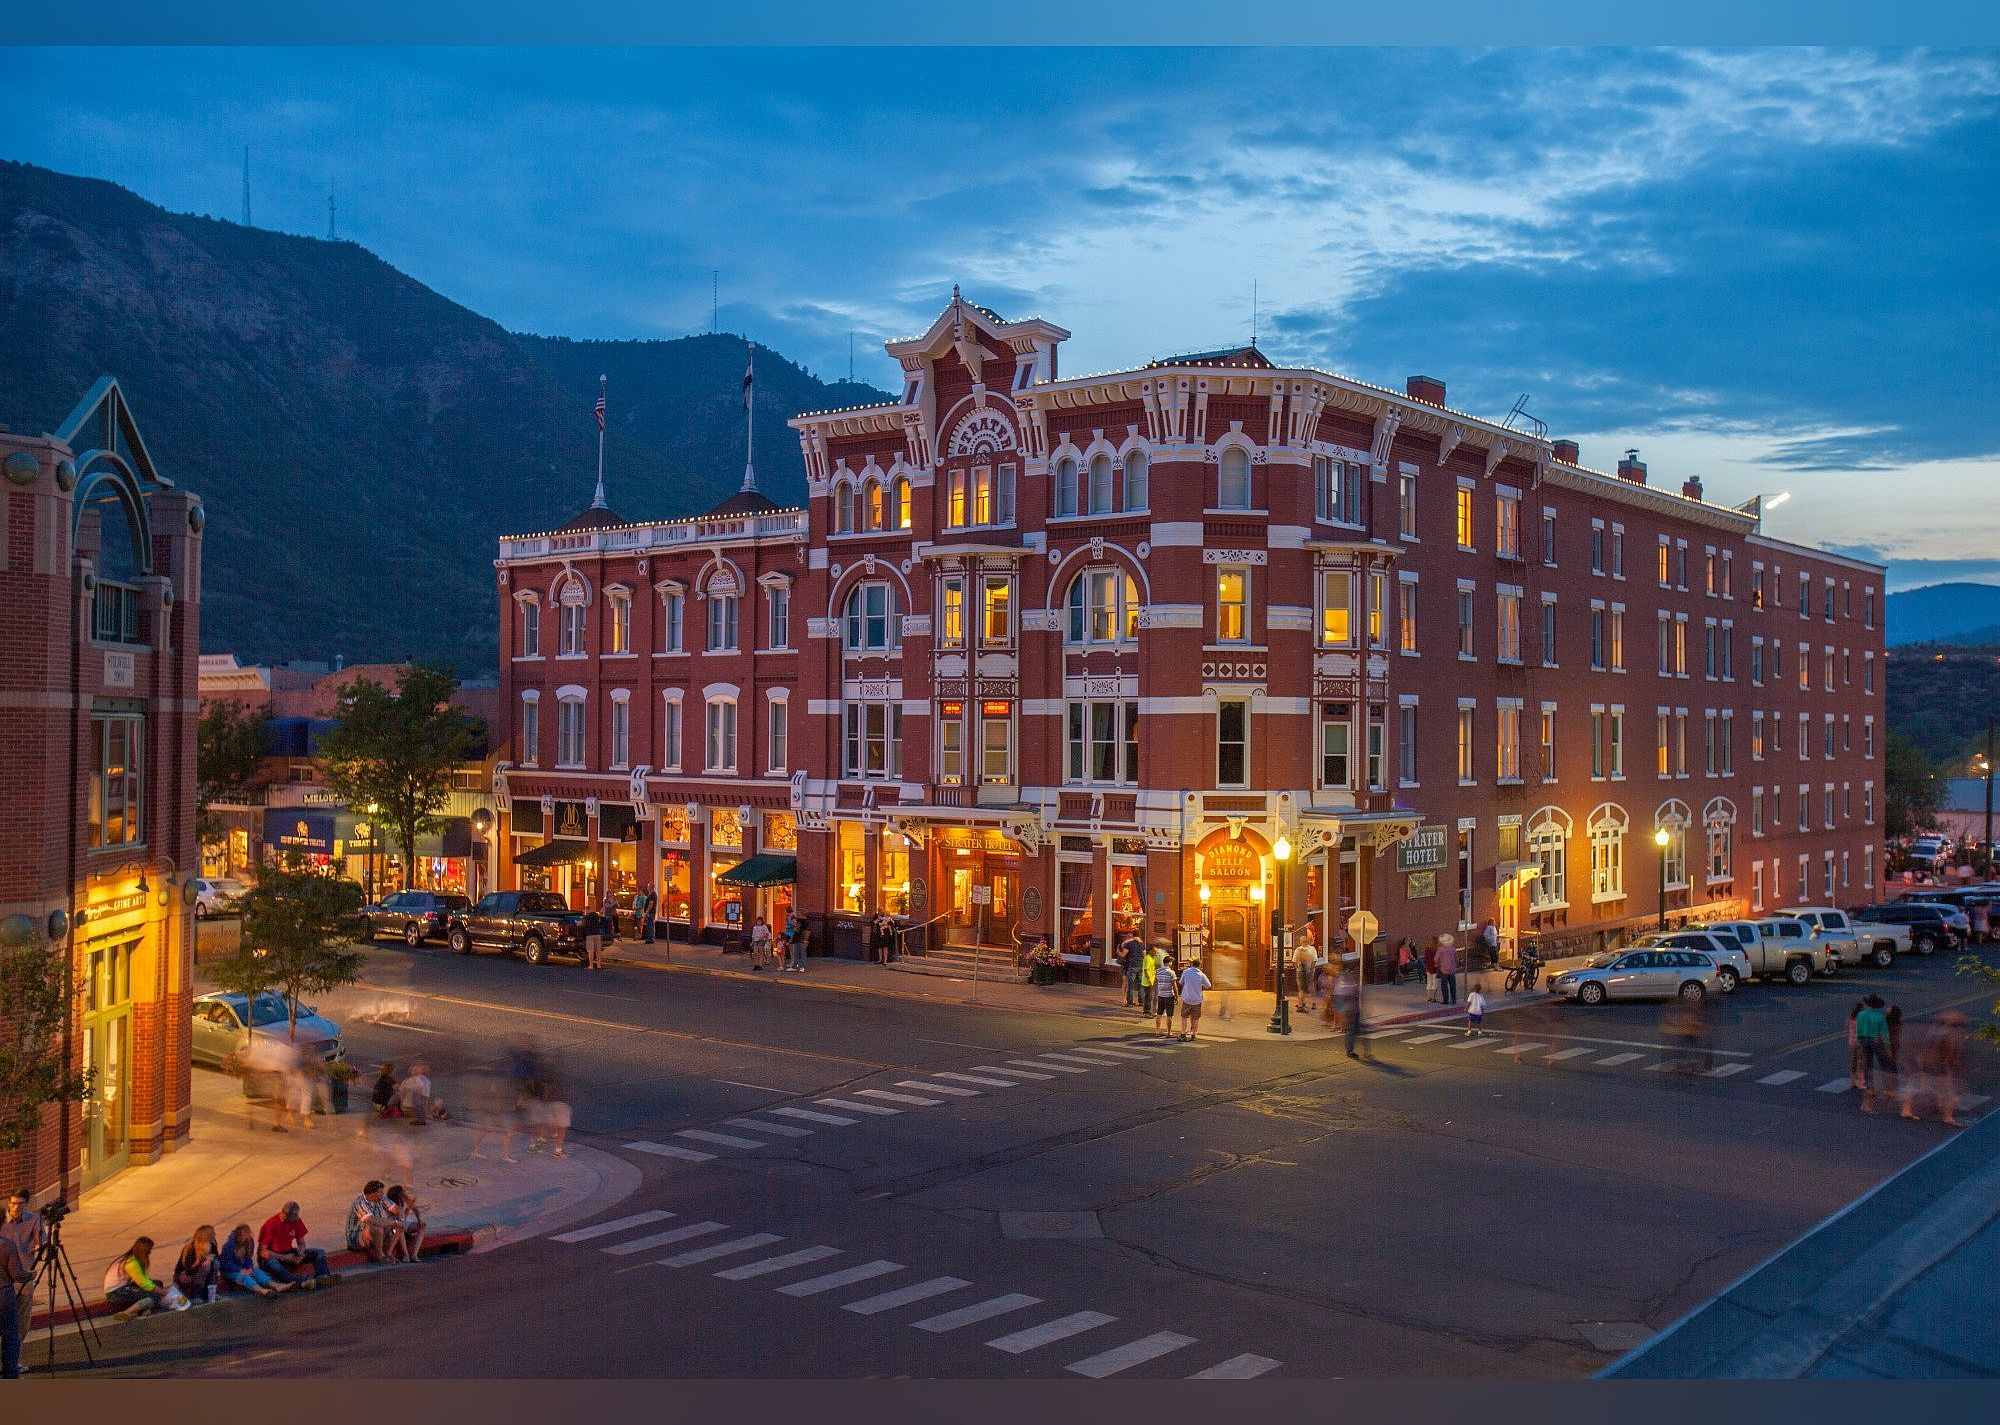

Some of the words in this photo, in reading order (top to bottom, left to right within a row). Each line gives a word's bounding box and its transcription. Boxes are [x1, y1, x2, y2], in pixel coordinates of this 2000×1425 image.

[957, 417, 1012, 454] STRATER
[349, 839, 377, 848] THEATE
[945, 838, 982, 849] STRATER
[985, 839, 1014, 851] HOTEL
[1208, 844, 1252, 858] DIAMOND
[1406, 848, 1438, 864] HOTEL
[1216, 857, 1243, 865] BELLE
[1210, 868, 1250, 876] SALOON
